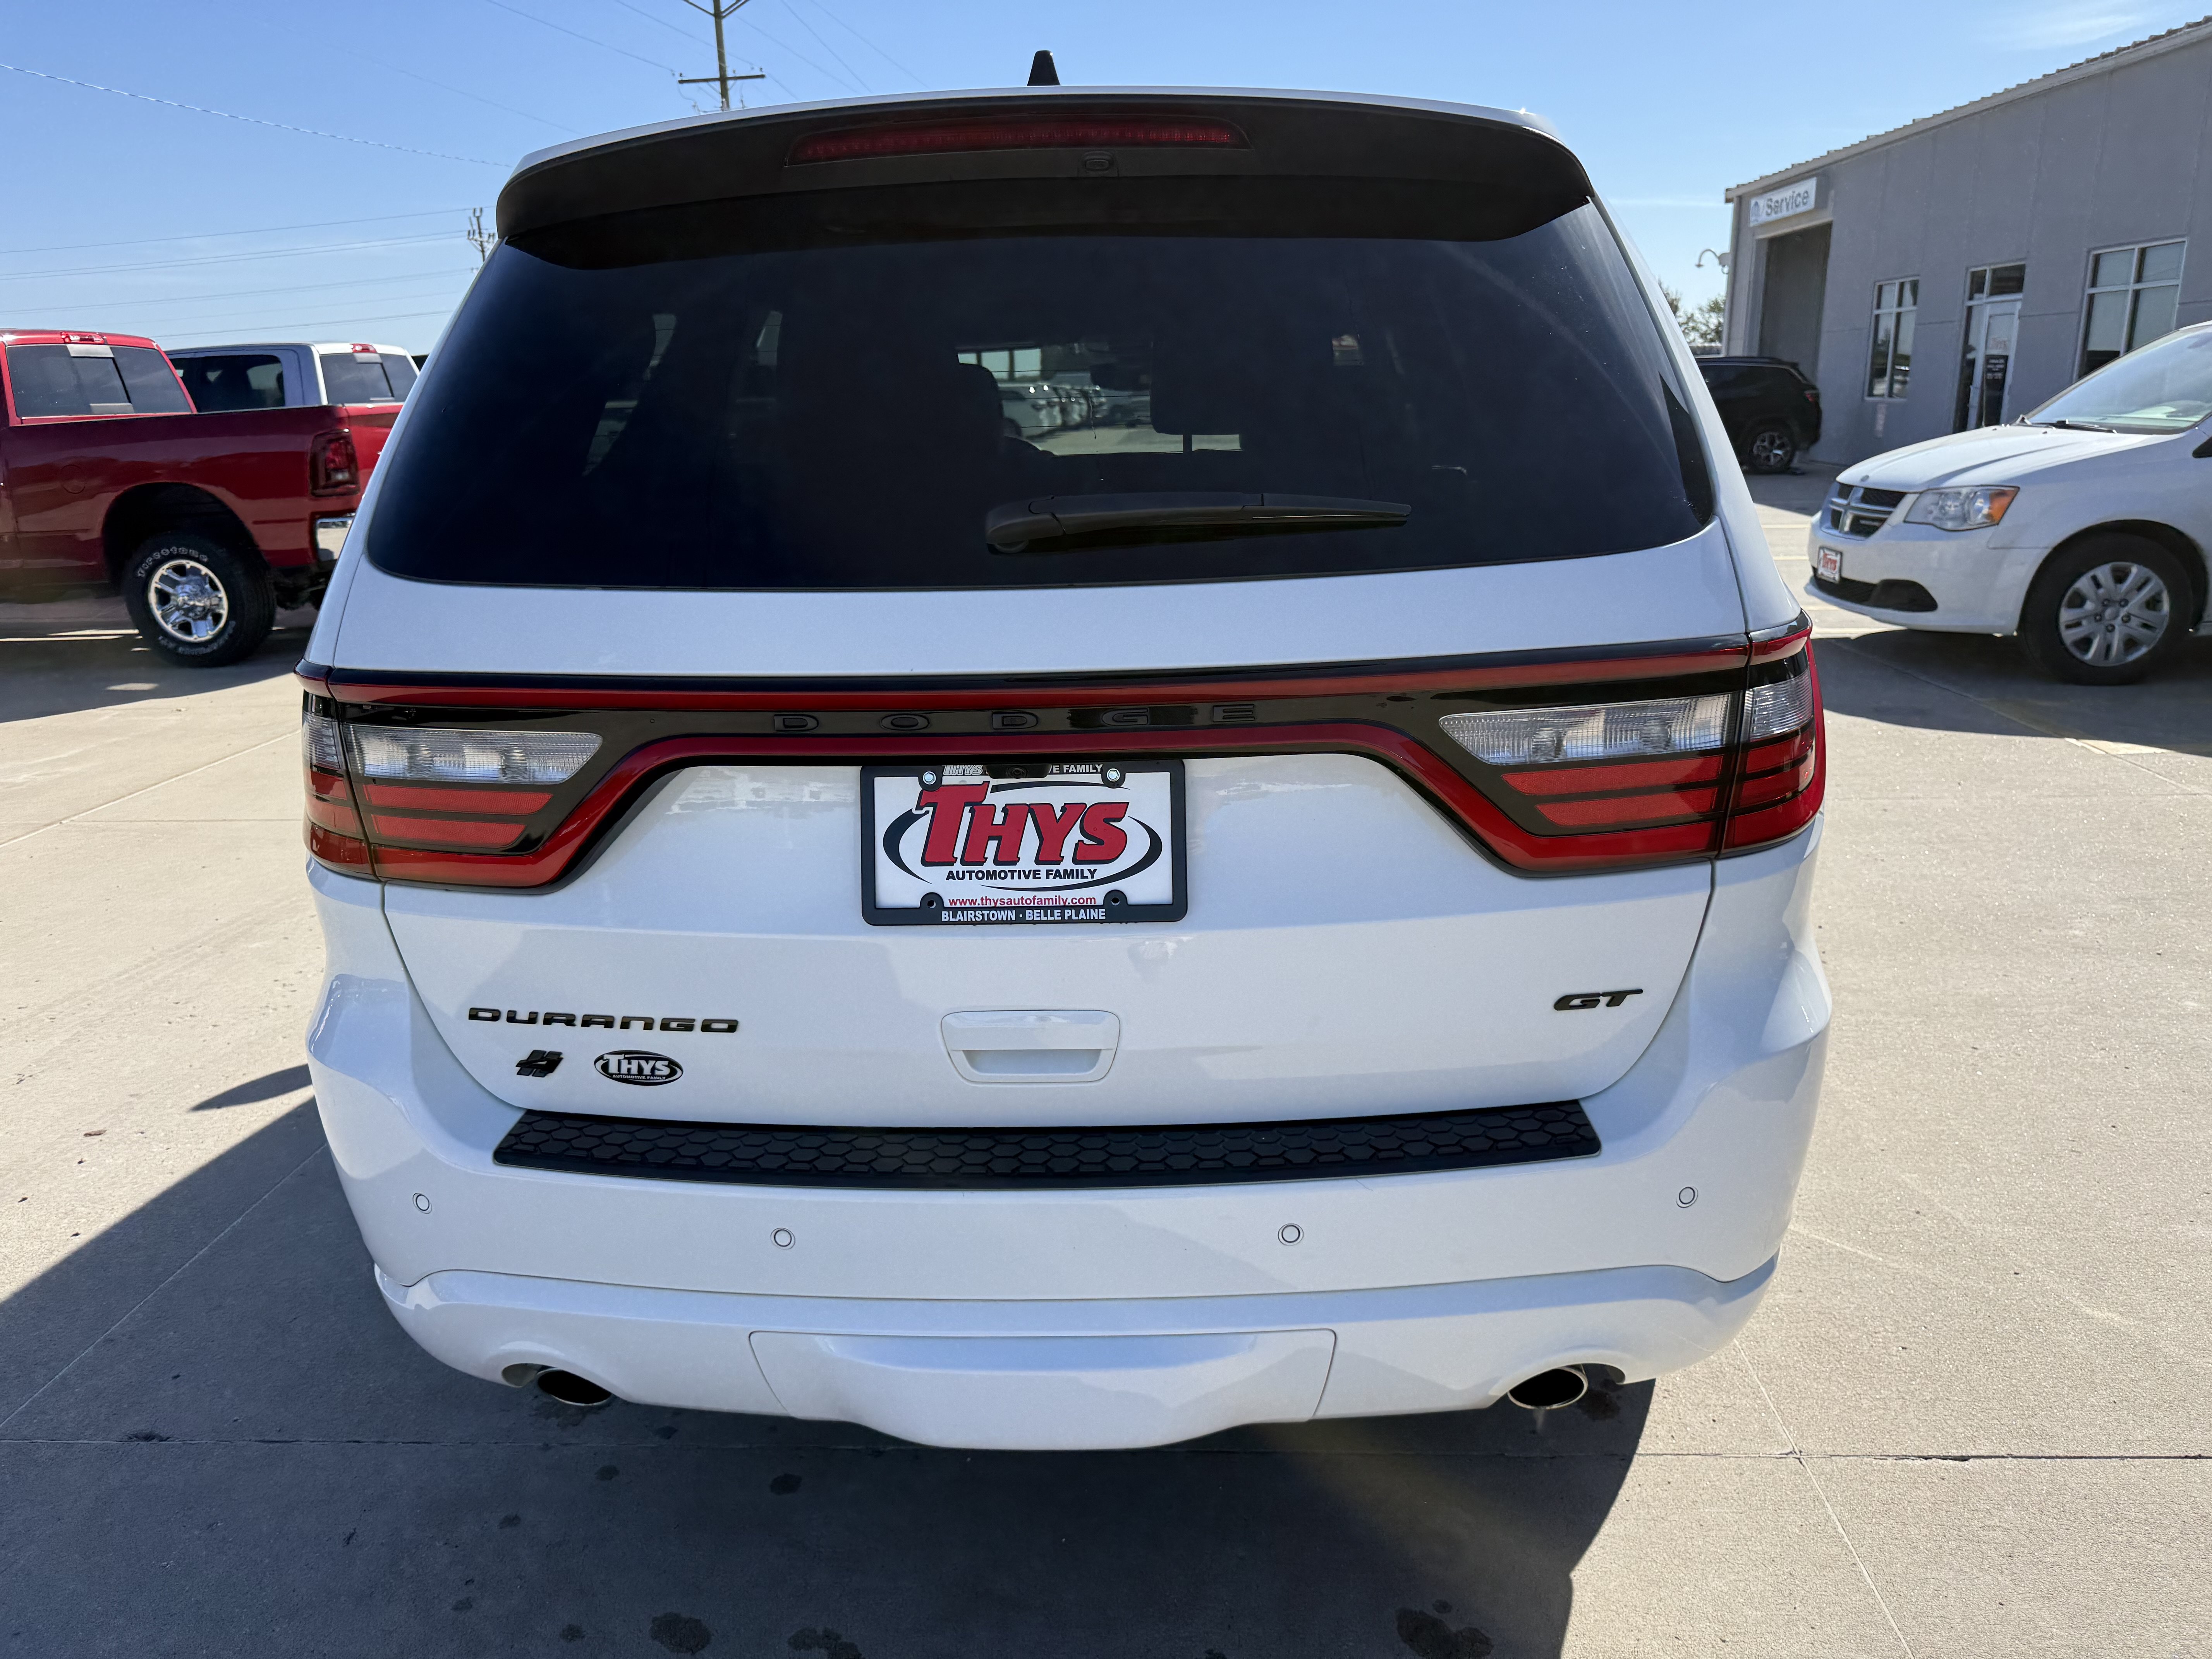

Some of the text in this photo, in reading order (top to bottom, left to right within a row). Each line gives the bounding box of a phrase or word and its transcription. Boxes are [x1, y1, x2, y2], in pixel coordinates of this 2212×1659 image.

[1765, 190, 1810, 216] Service
[773, 703, 1255, 732] DODGE
[1063, 764, 1103, 773] FAMILY
[916, 781, 1130, 866] THYS
[946, 869, 1097, 881] AUTOMOTIVE FAMILY
[948, 895, 1096, 907] www.thysautofamily.com
[941, 908, 1106, 922] BLAIRSTOWN BELLE PLAINE
[1554, 989, 1643, 1011] GT
[468, 1007, 739, 1033] DURANGO
[603, 1054, 671, 1076] THYS
